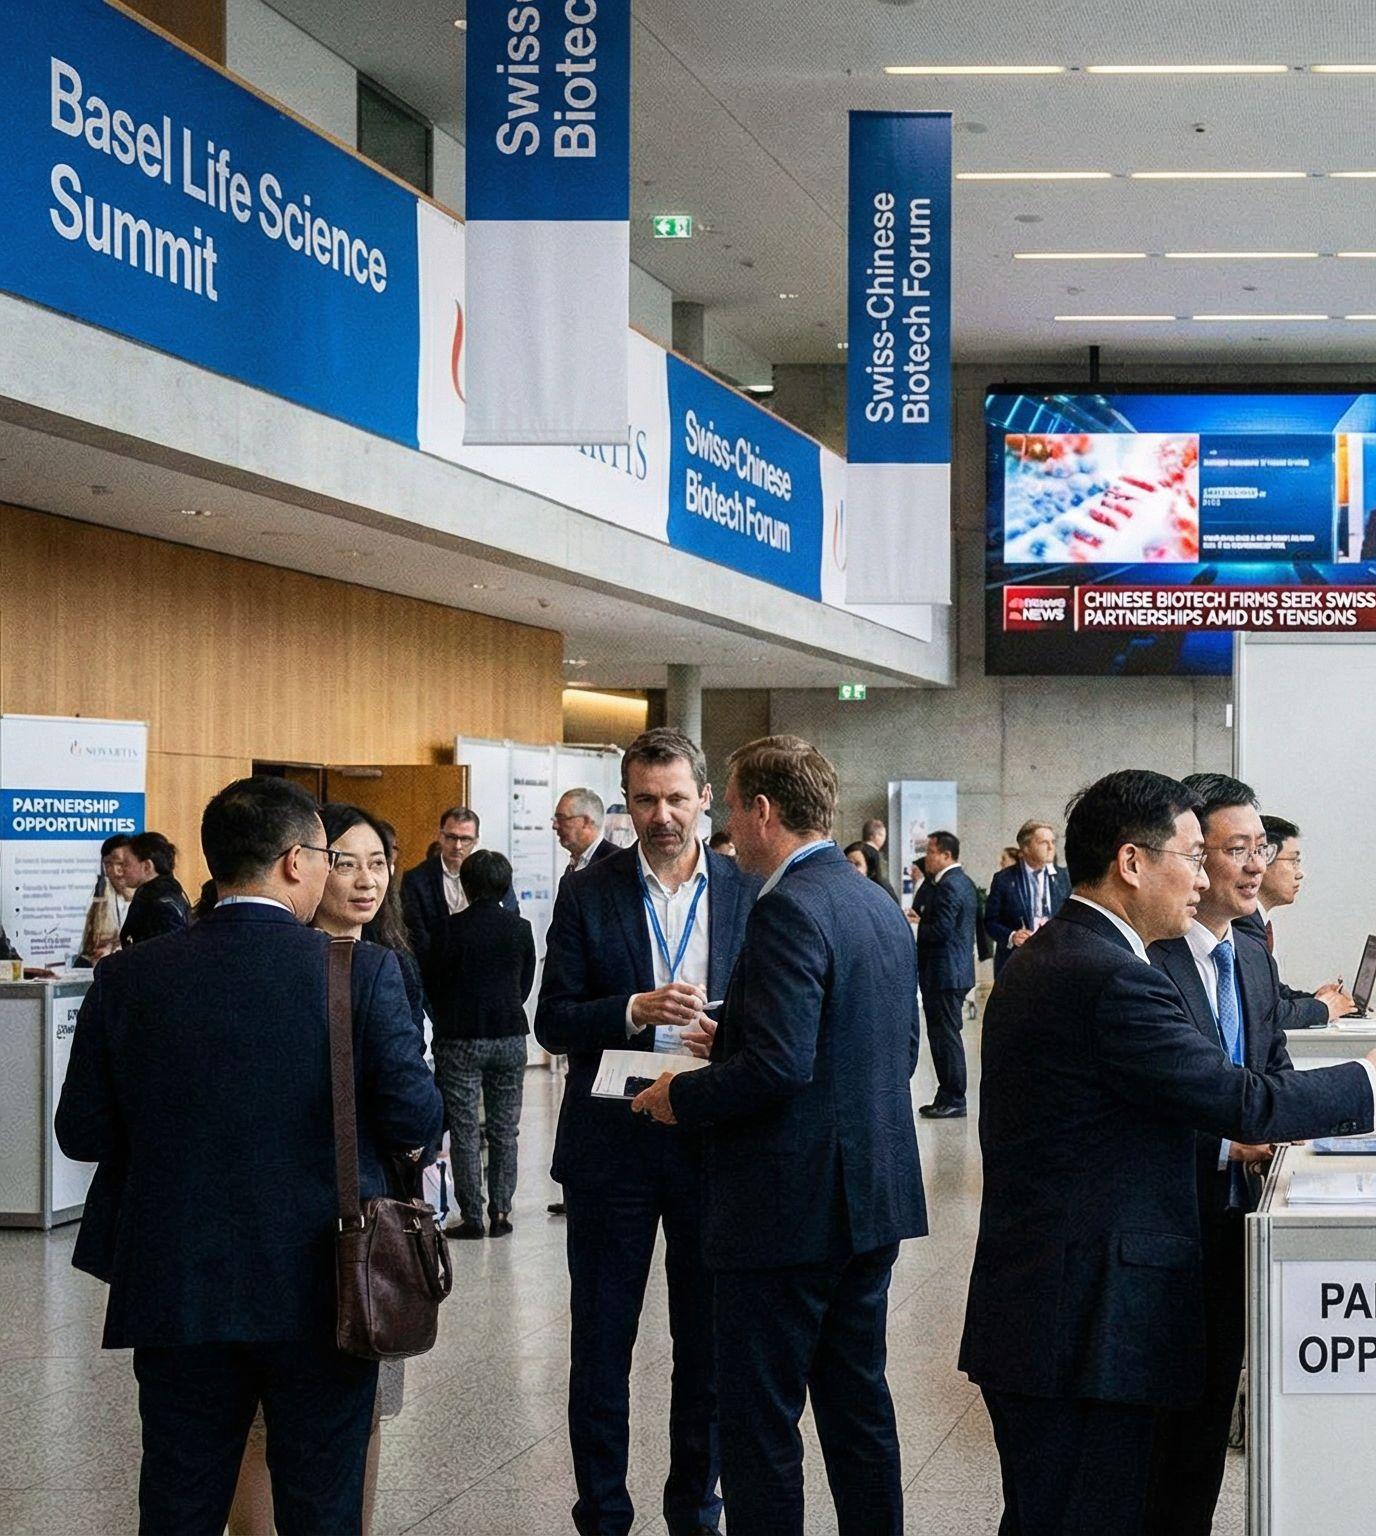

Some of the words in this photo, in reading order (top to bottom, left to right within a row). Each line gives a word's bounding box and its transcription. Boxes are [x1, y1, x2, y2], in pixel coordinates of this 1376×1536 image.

[496, 0, 541, 156] Swiss
[50, 56, 172, 185] Basel
[183, 127, 252, 224] Life
[258, 173, 388, 294] Science
[49, 163, 218, 302] Summit
[902, 198, 931, 297] Forum
[865, 192, 895, 424] Swiss-Chinese
[902, 305, 931, 424] Biotech
[684, 409, 792, 502] Swiss-Chinese
[685, 467, 745, 534] Biotech
[746, 496, 791, 554] Forum
[1022, 608, 1065, 621] NEWS
[1084, 591, 1153, 608] CHINESE
[1156, 591, 1227, 608] BIOTECH
[1229, 591, 1279, 608] FIRMS
[1280, 591, 1323, 608] SEEK
[1325, 591, 1376, 608] SWISS
[1084, 609, 1204, 626] PARTNERSHIPS
[1206, 609, 1249, 626] AMID
[1251, 609, 1275, 626] US
[1276, 609, 1358, 626] TENSIONS
[12, 797, 120, 814] PARTNERSHIP
[12, 816, 136, 833] OPPORTUNITIES
